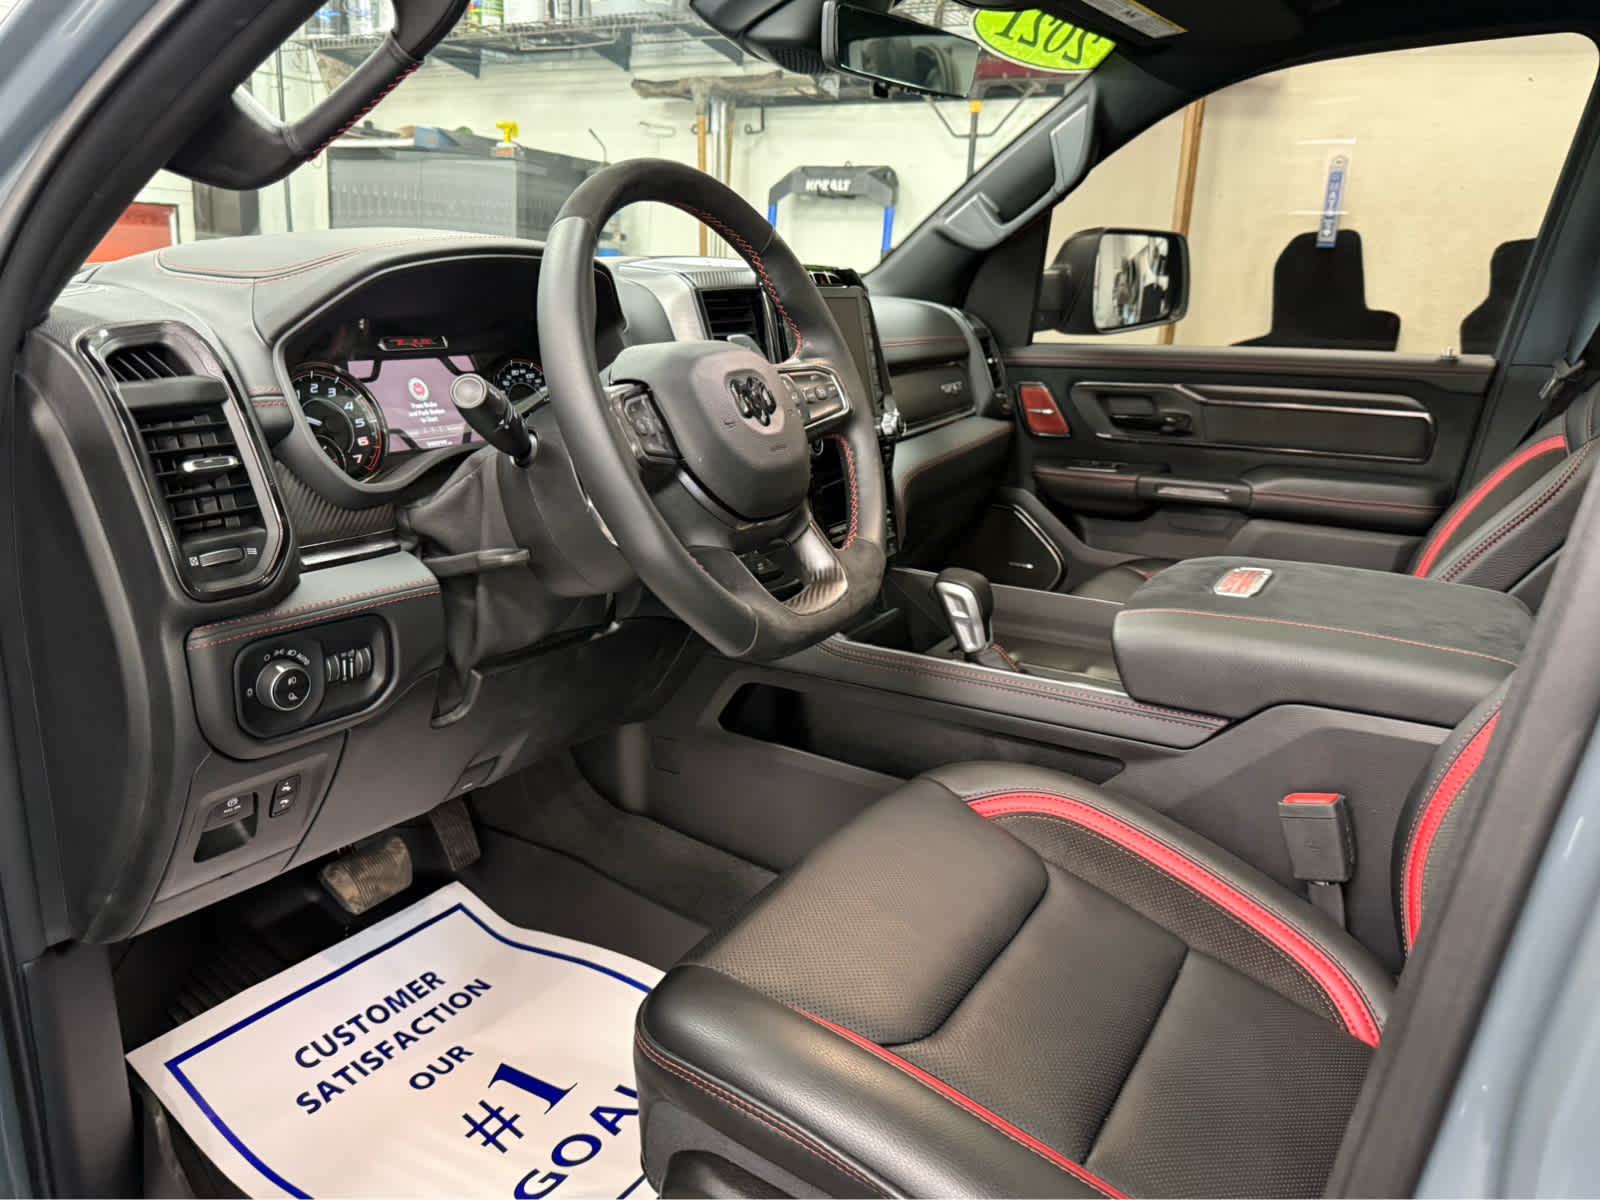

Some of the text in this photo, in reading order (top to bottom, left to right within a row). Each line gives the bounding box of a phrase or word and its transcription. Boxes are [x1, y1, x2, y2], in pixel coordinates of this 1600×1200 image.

[309, 383, 319, 394] 2
[327, 387, 337, 398] 3
[343, 401, 354, 411] 4
[354, 418, 366, 428] 5
[357, 436, 369, 447] 6
[352, 453, 364, 464] 7
[295, 971, 446, 1069] CUSTOMER
[296, 978, 493, 1115] SATISFACTION
[409, 1045, 475, 1090] OUR
[461, 1062, 578, 1154] #1
